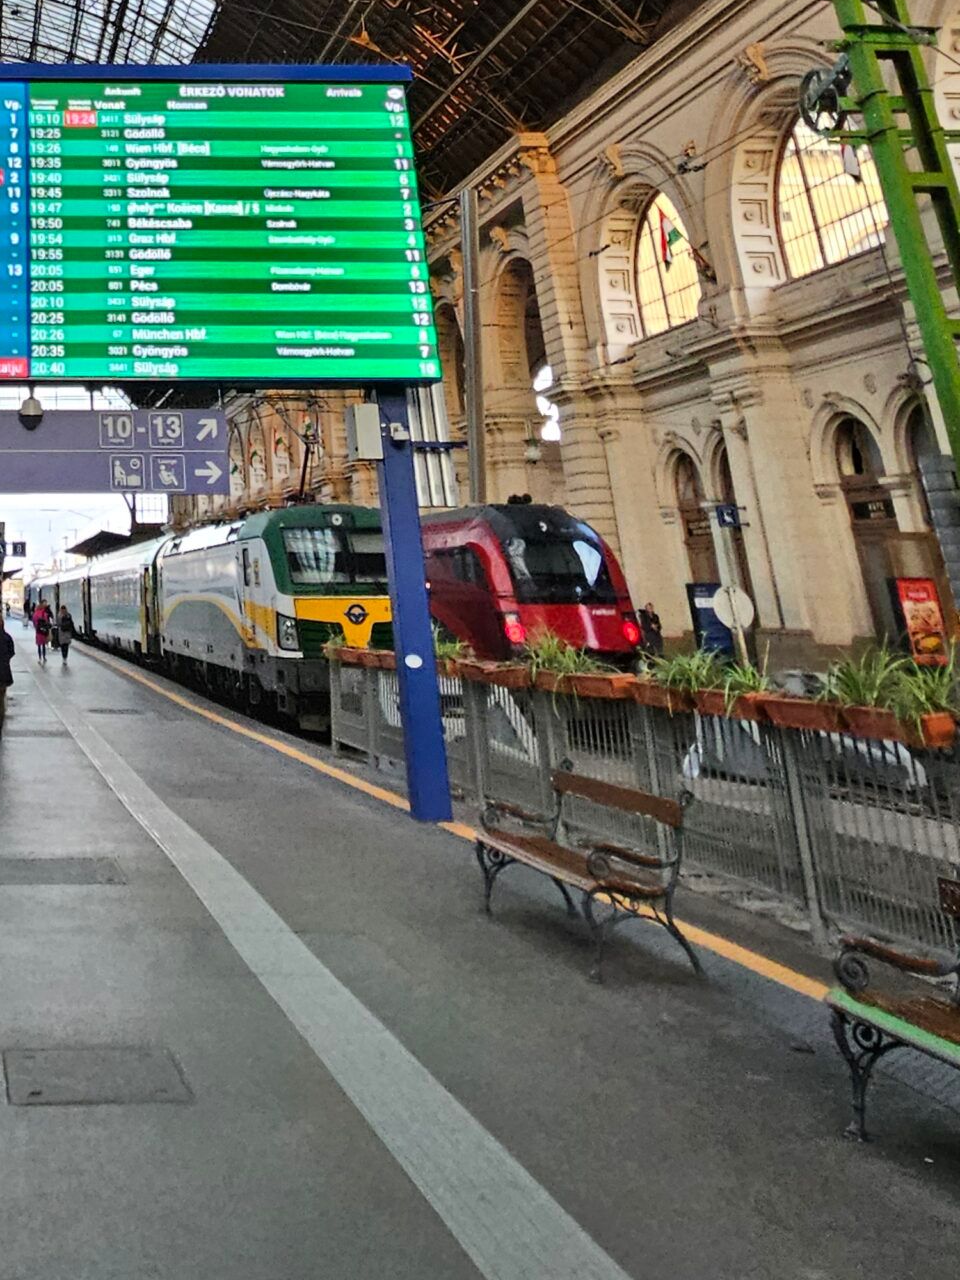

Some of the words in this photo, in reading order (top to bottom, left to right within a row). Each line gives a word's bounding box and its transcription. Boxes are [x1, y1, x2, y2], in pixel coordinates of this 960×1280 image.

[227, 87, 284, 97] VONATOK
[5, 100, 21, 110] Vg.
[94, 100, 126, 110] Vonat
[167, 100, 207, 110] Honnan
[11, 113, 16, 123] 1
[29, 114, 59, 124] 19:10
[124, 114, 165, 126] Sülysáp
[389, 116, 404, 127] 12
[10, 129, 18, 138] 7
[30, 129, 61, 139] 19:25
[10, 143, 18, 153] 8
[31, 144, 61, 153] 19:26
[125, 144, 151, 154] Wien
[8, 158, 21, 168] 12
[31, 159, 61, 168] 19:35
[126, 159, 177, 170] Gyöngyös
[394, 159, 408, 170] 11
[11, 173, 18, 183] 2
[31, 173, 62, 183] 19:40
[126, 173, 169, 185] Sülysáp
[399, 174, 408, 185] 6
[8, 188, 20, 198] 11
[31, 188, 62, 198] 19:45
[127, 188, 170, 198] Szolnok
[400, 189, 409, 200] 7
[11, 203, 18, 213] 5
[31, 203, 62, 213] 19:47
[403, 204, 412, 215] 2
[31, 218, 62, 229] 19:50
[128, 218, 192, 229] Békéscsaba
[405, 219, 414, 230] 3
[10, 233, 19, 244] 9
[32, 234, 62, 244] 19:54
[129, 233, 154, 244] Graz
[407, 234, 416, 246] 4
[32, 249, 63, 260] 19:55
[405, 250, 420, 261] 11
[8, 265, 22, 276] 13
[31, 265, 63, 276] 20:05
[130, 265, 155, 278] Eger
[32, 281, 64, 292] 20:05
[130, 281, 158, 292] Pécs
[409, 282, 425, 293] 13
[31, 297, 63, 308] 20:10
[131, 297, 175, 309] Sülysáp
[411, 298, 427, 310] 12
[31, 313, 64, 323] 20:25
[413, 313, 430, 325] 12
[31, 329, 64, 340] 20:26
[132, 328, 184, 340] München
[32, 346, 64, 356] 20:35
[133, 345, 188, 357] Gyöngyös
[420, 346, 430, 358] 7
[31, 362, 65, 373] 20:40
[134, 362, 178, 374] Sülysáp
[419, 363, 436, 374] 10
[102, 416, 131, 438] 10
[152, 416, 181, 438] 13
